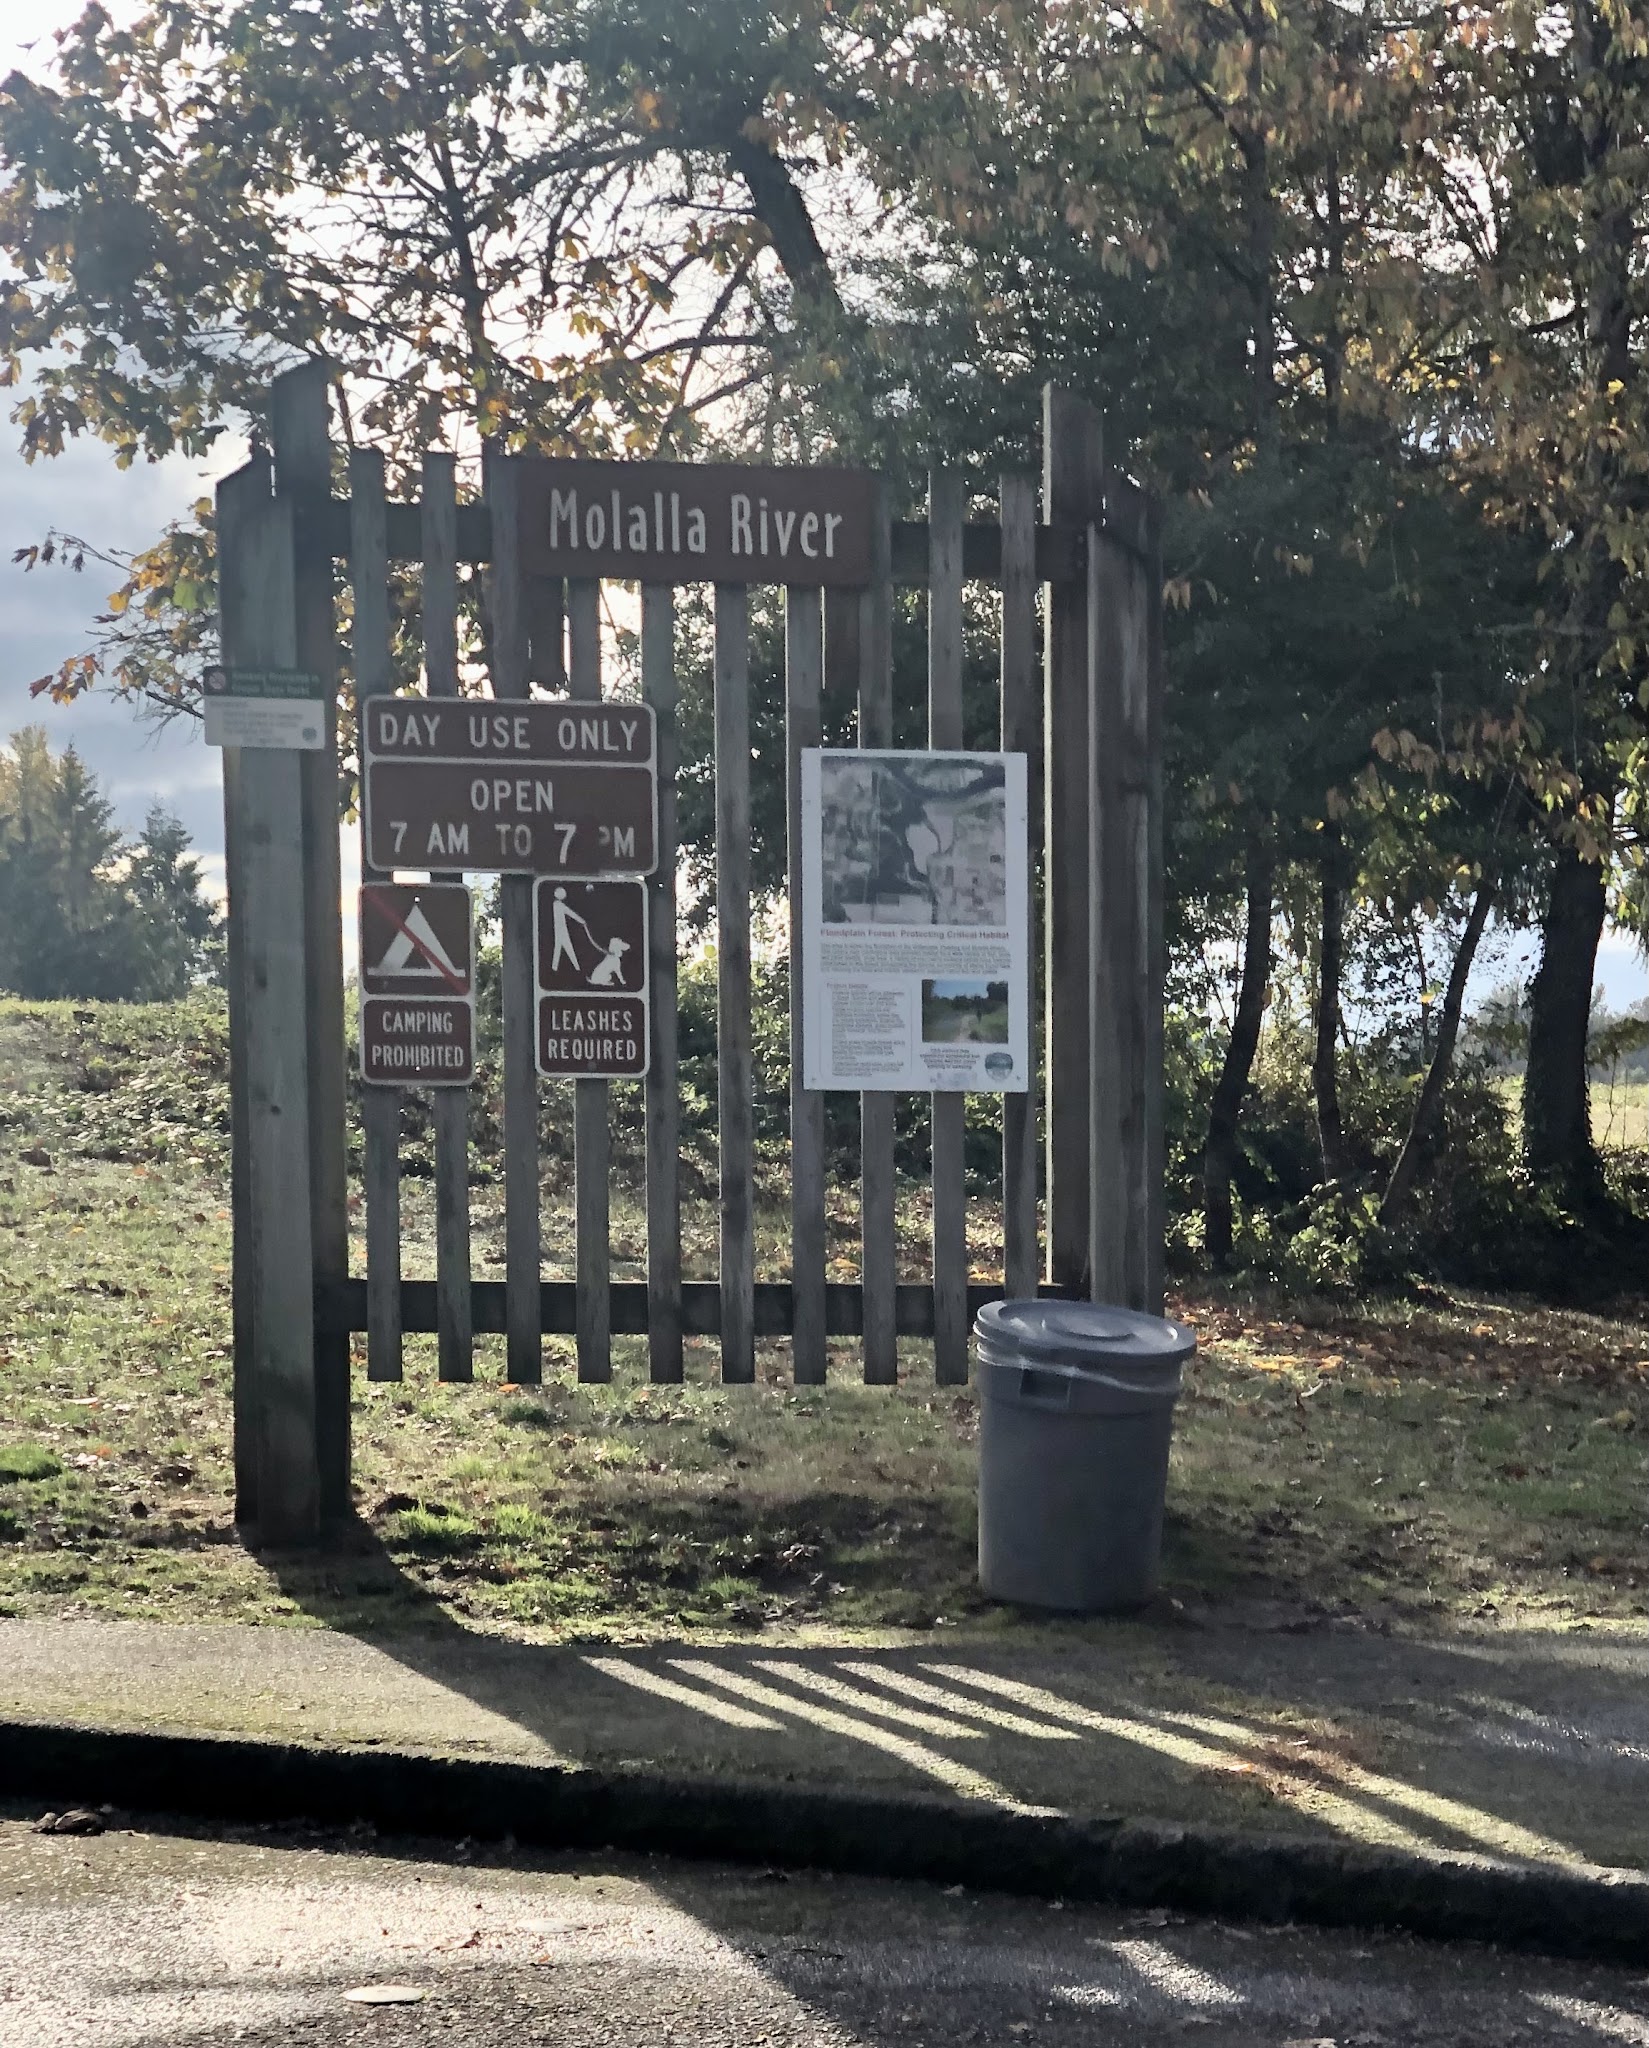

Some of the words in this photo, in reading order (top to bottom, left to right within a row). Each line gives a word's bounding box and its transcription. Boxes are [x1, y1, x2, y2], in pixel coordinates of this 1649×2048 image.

[550, 487, 707, 553] Molalla
[731, 494, 843, 558] River
[379, 713, 441, 747] DAY
[469, 716, 531, 750] USE
[558, 718, 638, 751] ONLY
[470, 779, 554, 812] OPEN
[390, 821, 408, 853] 7
[426, 822, 470, 855] AM
[495, 823, 532, 856] TO
[553, 823, 577, 864] 7
[382, 1010, 453, 1034] CAMPING
[551, 1009, 633, 1032] LEASHES
[371, 1045, 464, 1067] PROHIBITED
[547, 1038, 637, 1061] REQUIRED
